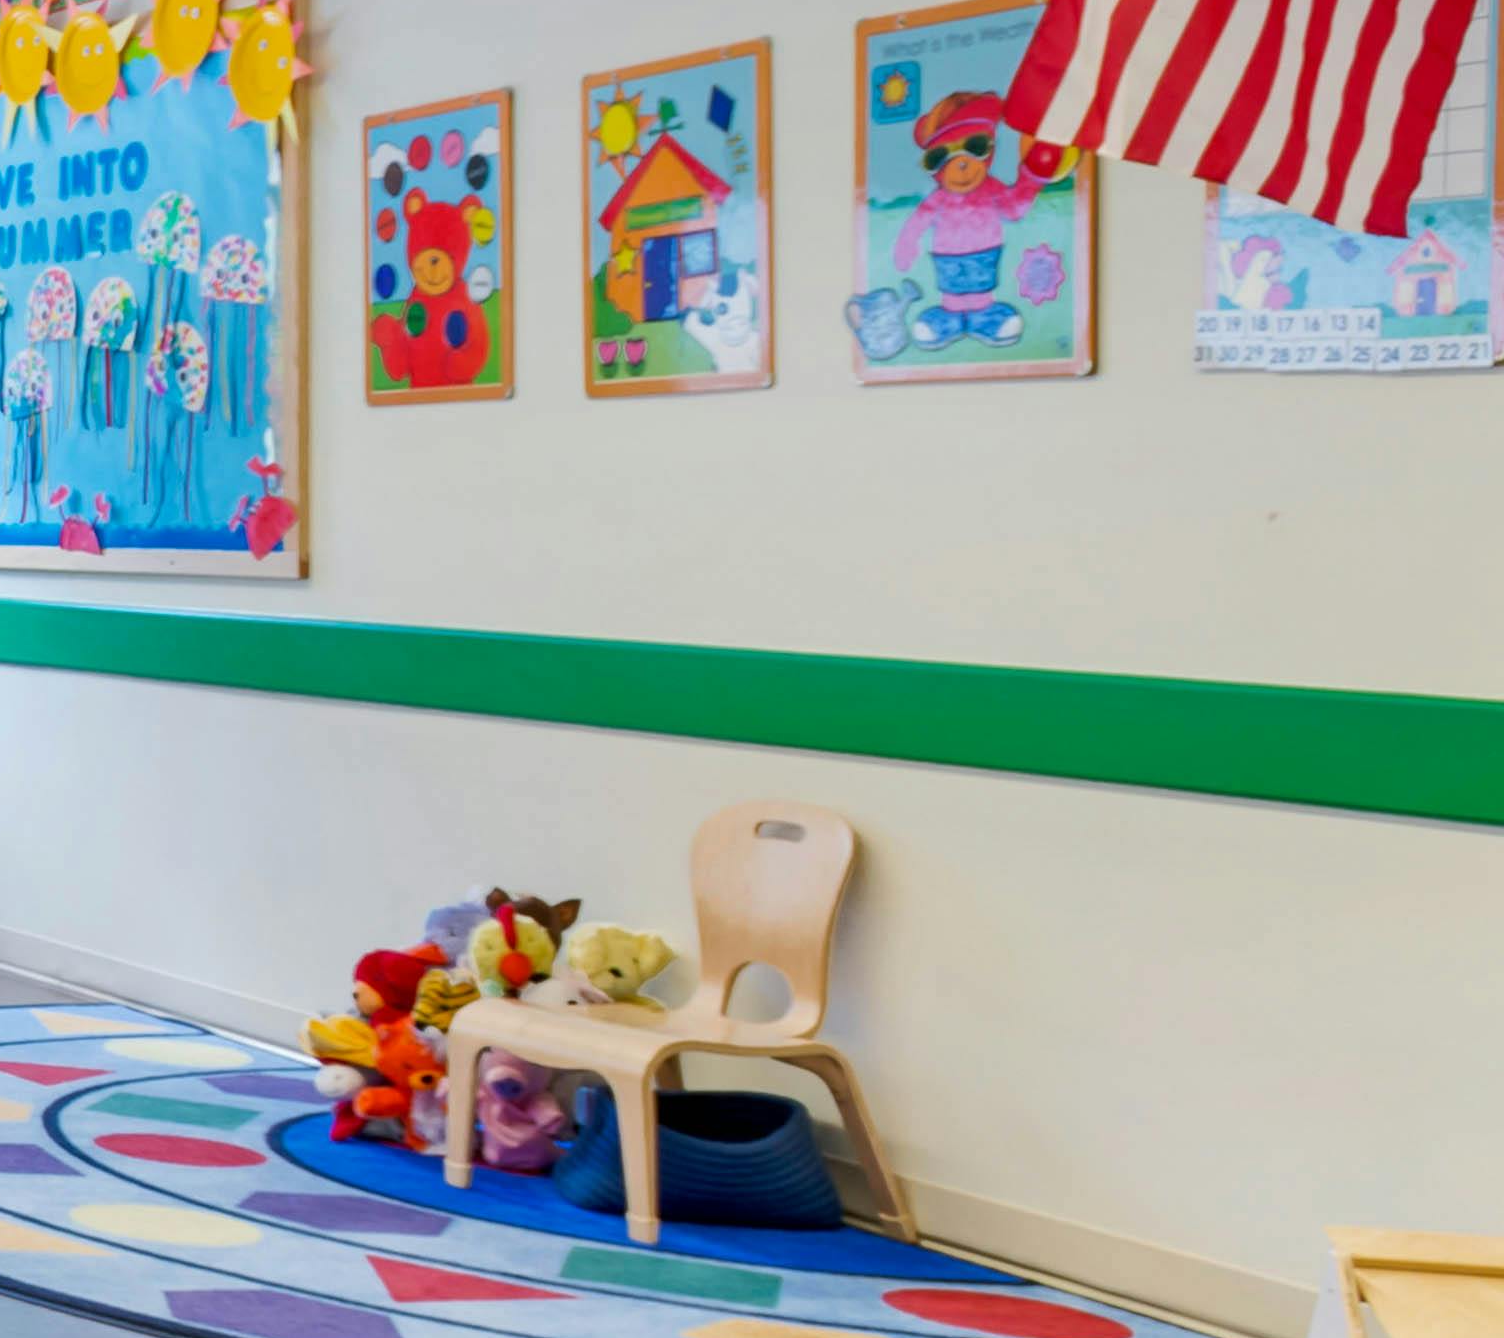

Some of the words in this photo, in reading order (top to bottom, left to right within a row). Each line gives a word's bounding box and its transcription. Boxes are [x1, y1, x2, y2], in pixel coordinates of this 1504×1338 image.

[59, 140, 149, 201] INTO
[1277, 317, 1295, 333] 17
[1357, 316, 1375, 331] 14
[1296, 347, 1317, 363] 27
[1381, 346, 1400, 363] 24
[1409, 344, 1429, 361] 23
[1438, 342, 1460, 360] 22
[1468, 341, 1489, 359] 21
